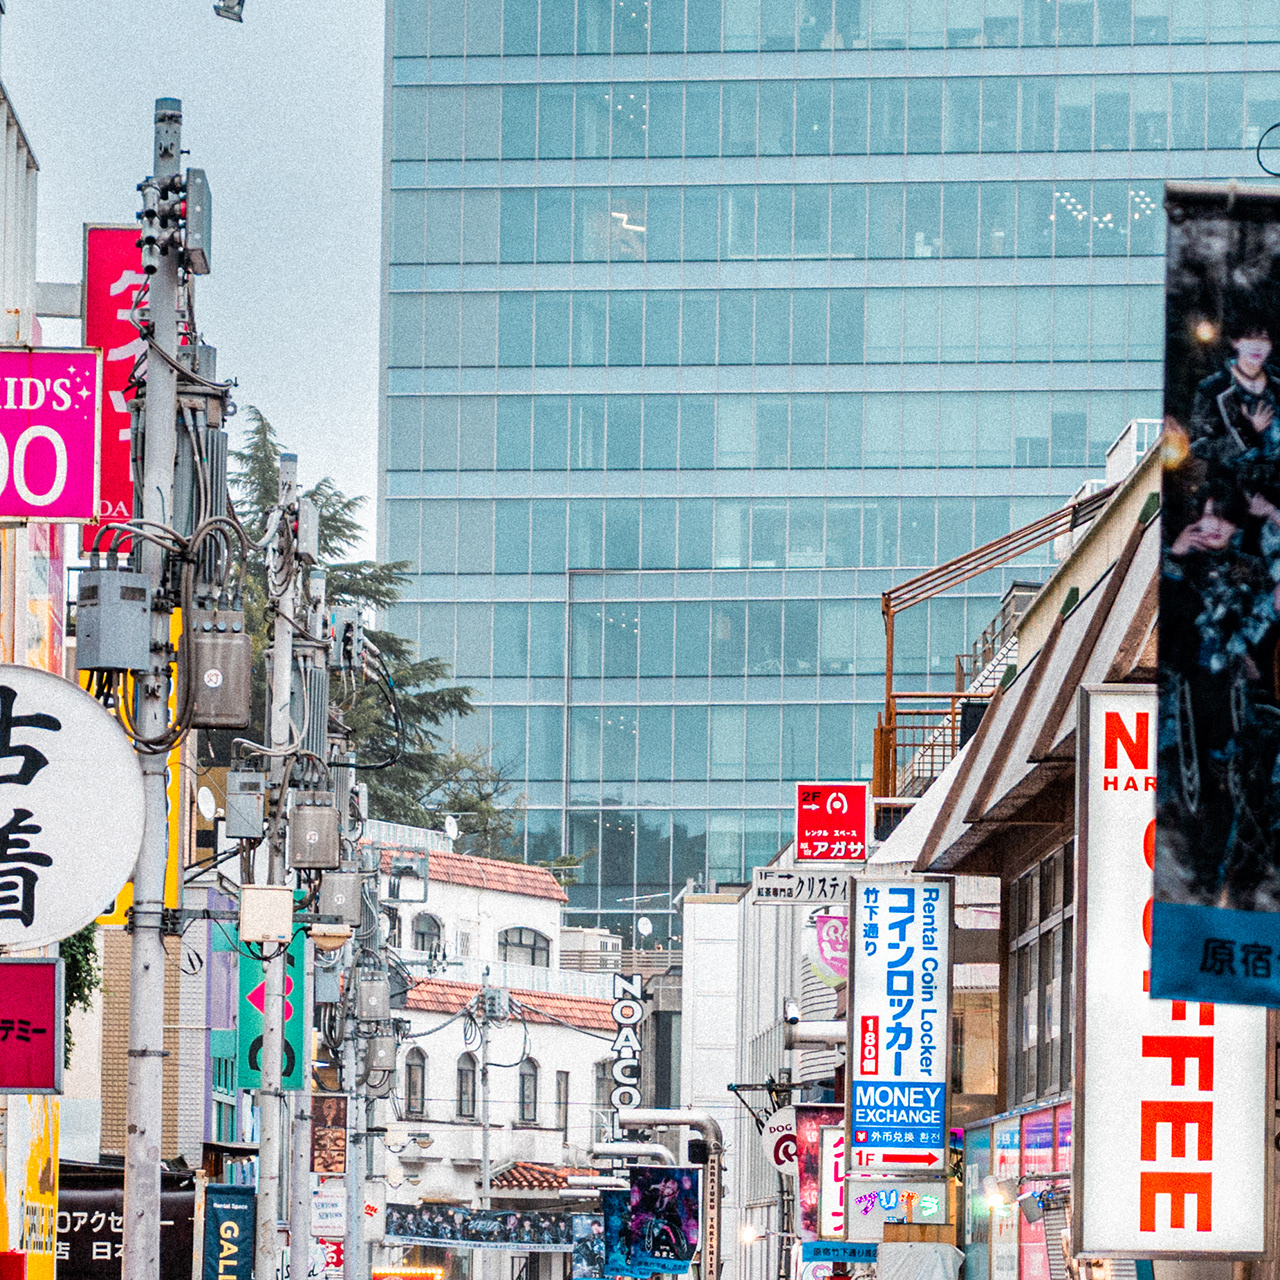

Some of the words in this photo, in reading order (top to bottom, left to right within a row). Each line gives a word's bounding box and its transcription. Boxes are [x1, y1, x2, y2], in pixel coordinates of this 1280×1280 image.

[801, 792, 821, 802] 2F
[813, 841, 865, 857] アガサ
[863, 887, 880, 956] 竹下通り
[922, 887, 940, 951] Rental
[886, 887, 915, 1077] コインロッカー
[921, 957, 939, 1002] Coin
[920, 1008, 938, 1077] Locker
[856, 1086, 941, 1107] MONEY
[856, 1109, 940, 1123] EXCHANGE
[769, 1123, 793, 1134] DOG
[871, 1131, 914, 1143] 外币兑换
[855, 1150, 875, 1166] 1F
[707, 1217, 715, 1276] TAKESHITA
